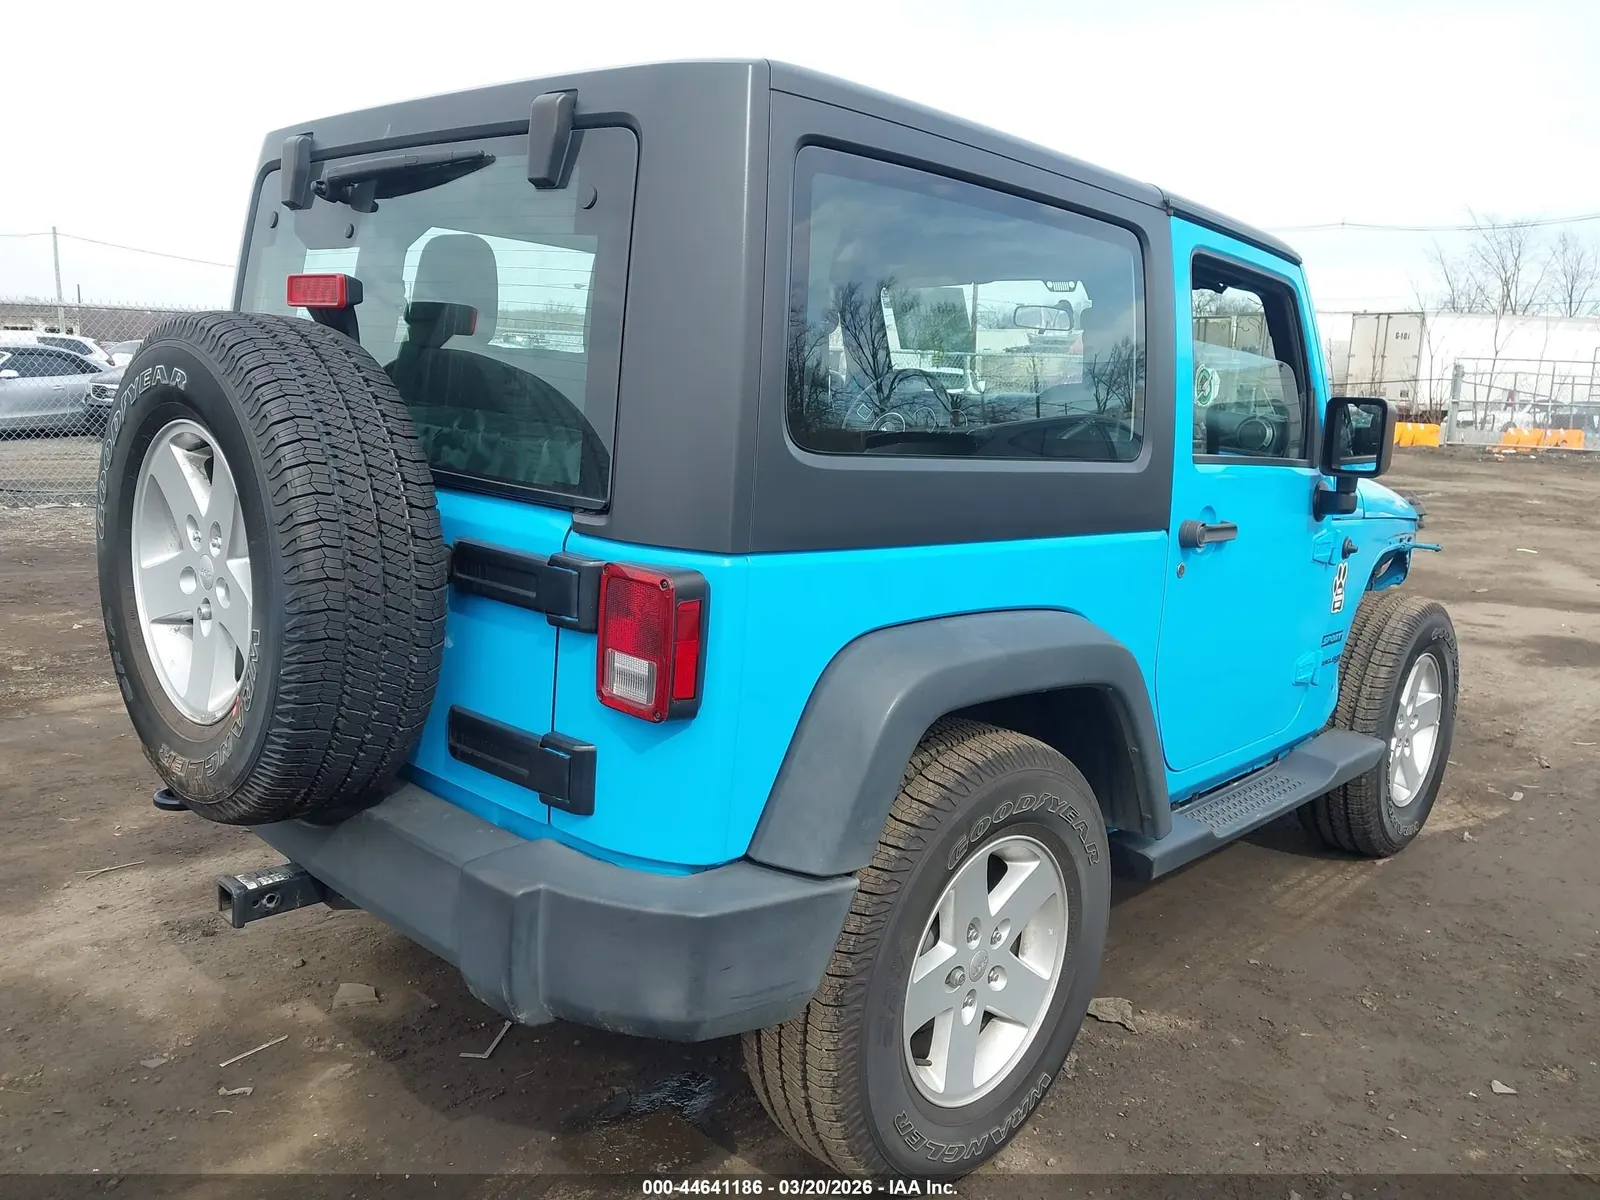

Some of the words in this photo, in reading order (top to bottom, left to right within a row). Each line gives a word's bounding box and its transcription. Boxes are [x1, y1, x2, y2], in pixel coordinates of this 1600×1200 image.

[97, 364, 188, 540] GOODYEAR
[159, 629, 261, 779] WRANGLER
[947, 792, 1101, 871] GOODYEAR
[893, 1071, 1053, 1164] WRANGLER
